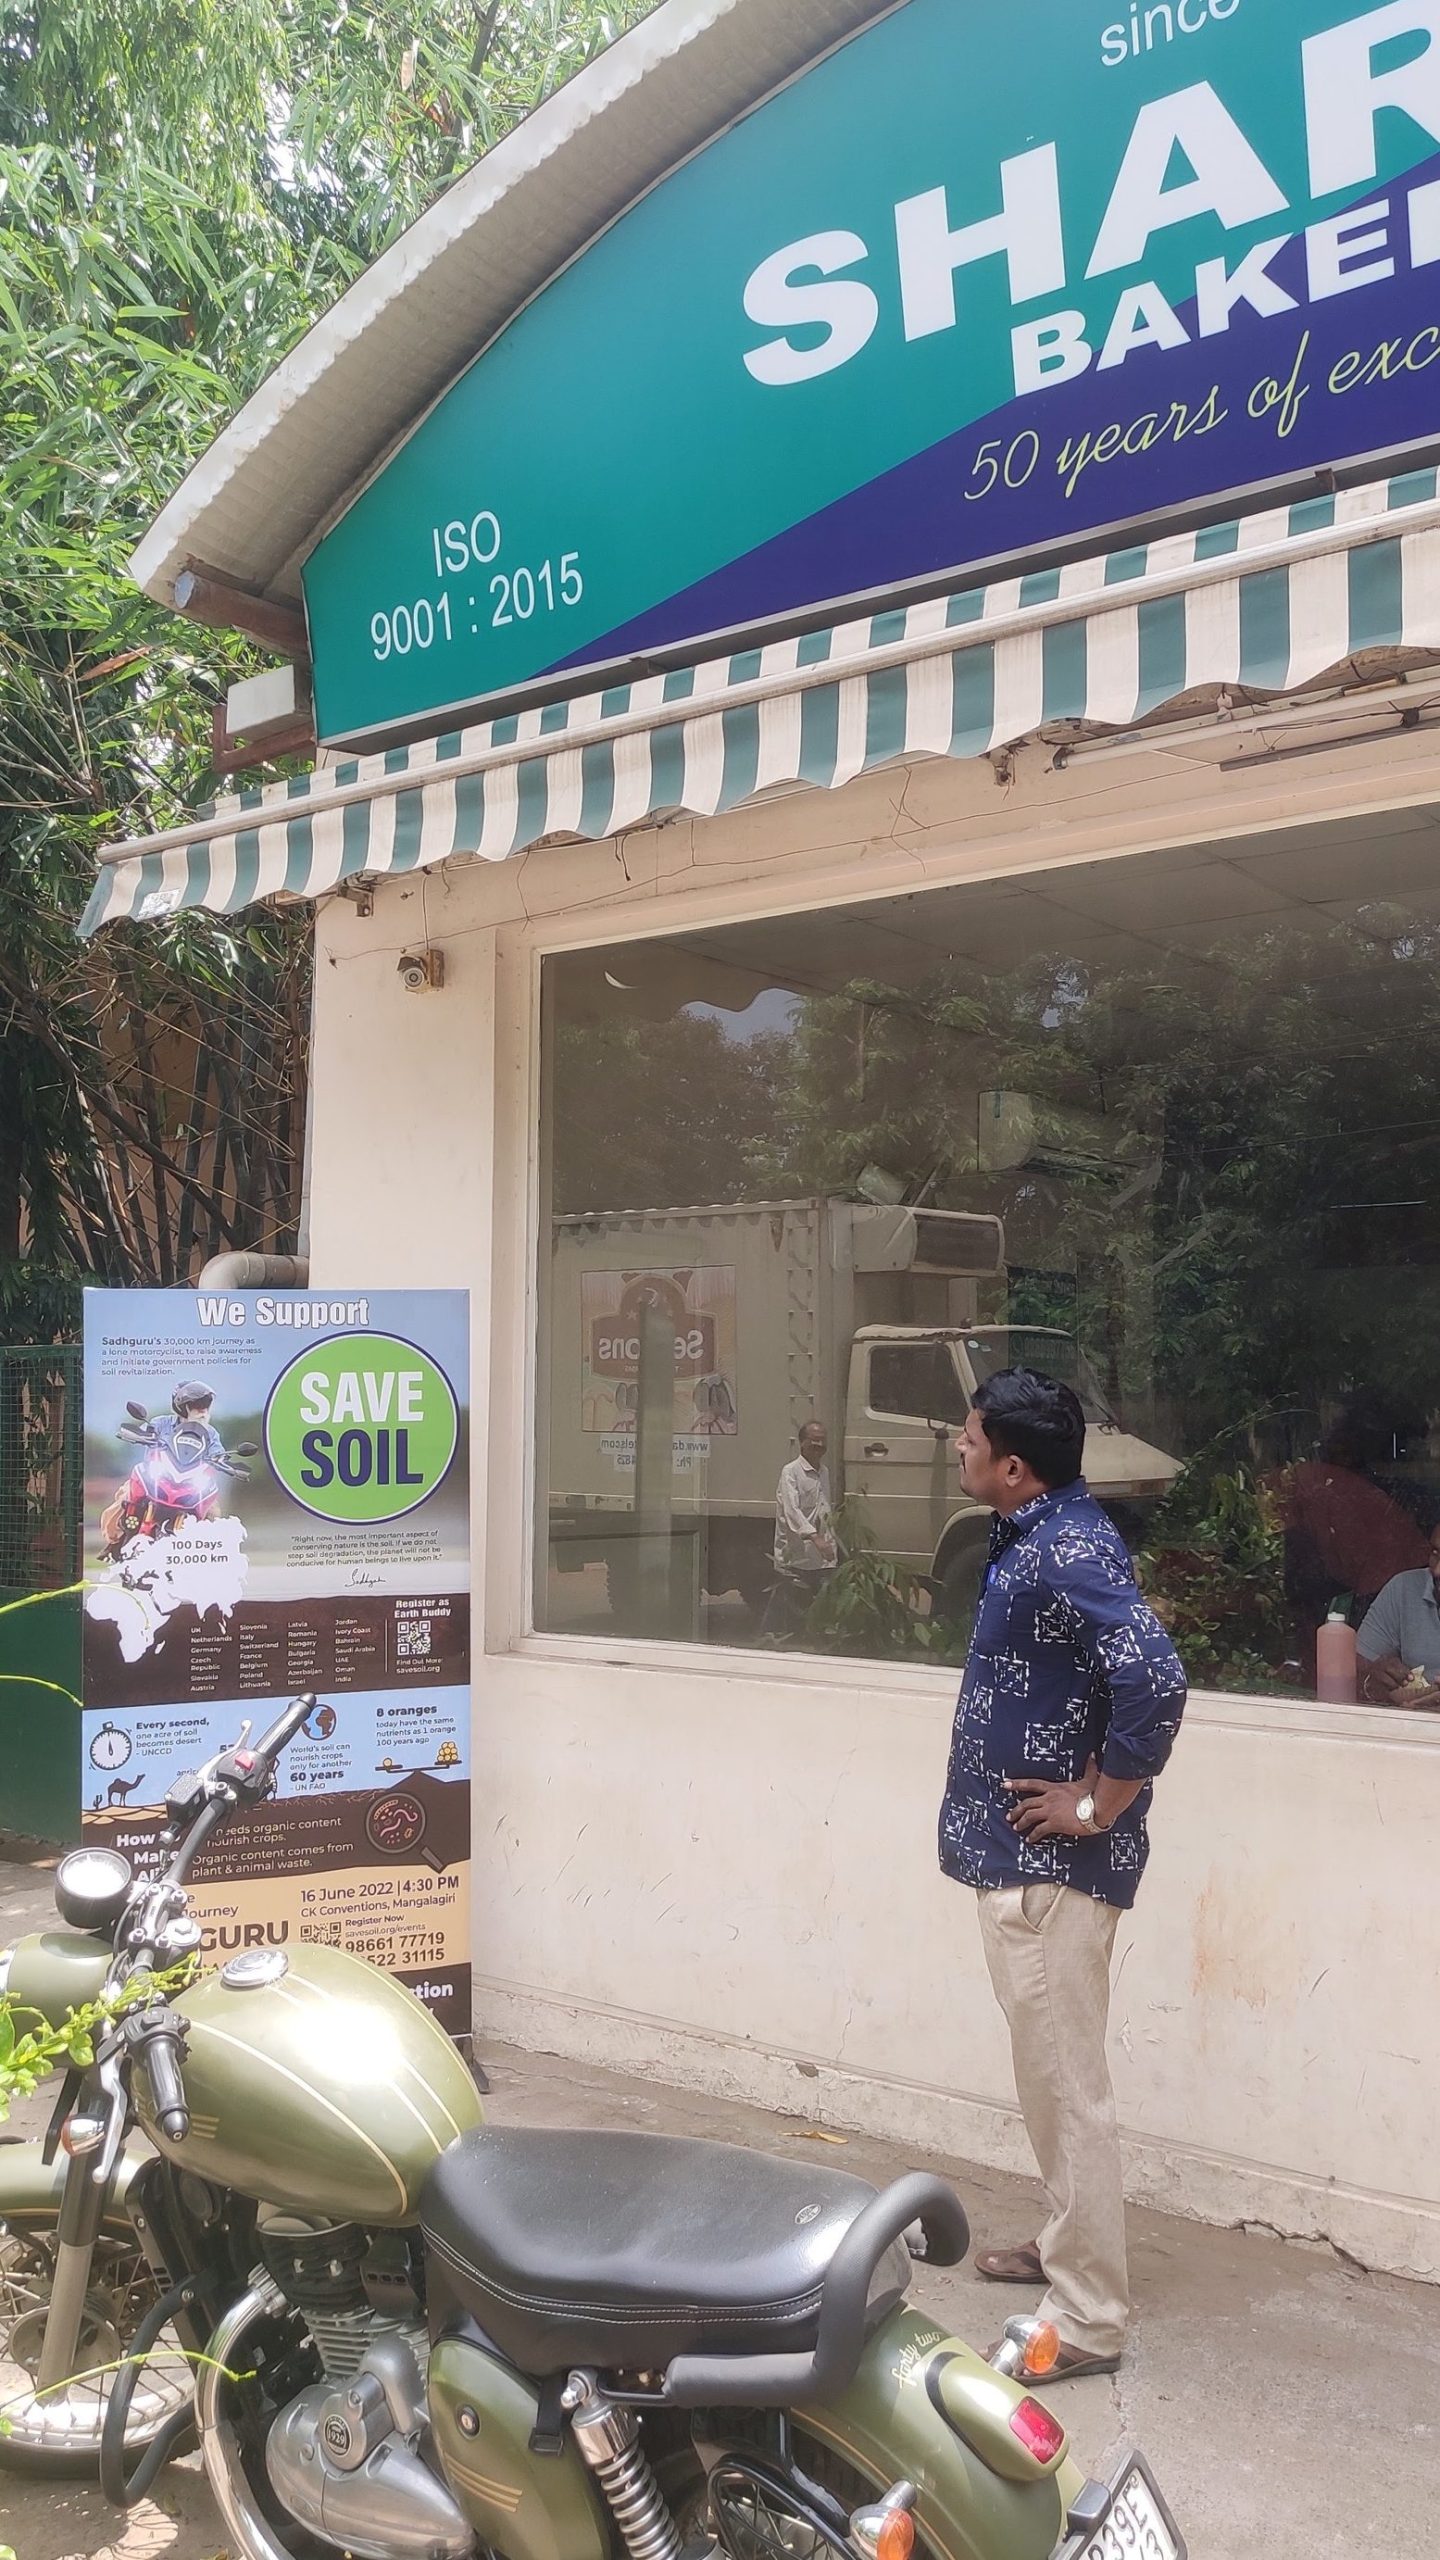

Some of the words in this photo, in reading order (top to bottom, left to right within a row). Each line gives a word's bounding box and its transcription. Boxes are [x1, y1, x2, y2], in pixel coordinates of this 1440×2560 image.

[964, 431, 1039, 501] 50
[1057, 385, 1228, 498] years
[1247, 331, 1310, 437] of
[433, 510, 500, 577] ISO
[371, 591, 451, 661] 9001
[489, 551, 583, 628] 2015
[196, 1297, 246, 1327] We
[256, 1297, 369, 1329] Support
[102, 1337, 162, 1347] Sadhguru's
[164, 1338, 195, 1346] 30,000
[211, 1338, 244, 1346] journey
[197, 1347, 216, 1355] raise
[102, 1358, 118, 1366] and
[120, 1358, 151, 1366] initiate
[152, 1358, 205, 1367] government
[207, 1357, 238, 1366] policies
[301, 1371, 424, 1424] SAVE
[301, 1429, 424, 1488] SOIL
[368, 1533, 404, 1541] important
[172, 1541, 191, 1550] 100
[195, 1541, 222, 1550] Days
[292, 1543, 332, 1551] conserving
[211, 1554, 228, 1562] km
[396, 1599, 436, 1609] Register
[395, 1609, 419, 1618] Earth
[422, 1608, 451, 1618] Buddy
[335, 1618, 358, 1626] Jordan
[335, 1628, 351, 1636] Ivory
[190, 1635, 232, 1643] Netherlands
[190, 1646, 221, 1654] Germany
[288, 1650, 315, 1658] Bulgaria
[190, 1664, 220, 1672] Republic
[240, 1662, 268, 1670] Belgium
[288, 1659, 313, 1667] Georgia
[288, 1668, 322, 1676] Azerbaijan
[396, 1666, 441, 1675] savesoil.org
[376, 1708, 384, 1717] 8
[388, 1705, 437, 1718] oranges
[136, 1721, 166, 1731] Every
[169, 1718, 209, 1728] second,
[376, 1720, 398, 1729] today
[400, 1719, 418, 1727] have
[184, 1728, 198, 1736] soil
[376, 1729, 411, 1737] nutrients
[429, 1726, 456, 1735] orange
[136, 1739, 174, 1748] becomes
[175, 1738, 202, 1746] desert
[393, 1738, 414, 1746] years
[416, 1737, 429, 1745] ago
[142, 1747, 172, 1756] UNCCD
[290, 1745, 319, 1753] World's
[290, 1754, 320, 1762] nourish
[322, 1752, 343, 1760] crops
[290, 1763, 307, 1771] only
[322, 1760, 352, 1768] another
[290, 1772, 306, 1782] 60
[310, 1770, 344, 1782] years
[253, 1821, 295, 1835] organic
[298, 1817, 341, 1829] content
[116, 1834, 156, 1847] How
[253, 1833, 286, 1845] crops.
[192, 1853, 238, 1866] Organic
[240, 1849, 285, 1860] content
[287, 1846, 324, 1857] comes
[327, 1842, 353, 1853] from
[192, 1866, 222, 1879] plant
[225, 1864, 233, 1874] &
[235, 1861, 275, 1873] animal
[277, 1858, 312, 1869] waste.
[301, 1889, 315, 1902] 16
[319, 1887, 355, 1900] June
[359, 1882, 393, 1897] 2022
[403, 1878, 433, 1892] 4:30
[438, 1875, 459, 1889] PM
[301, 1908, 317, 1917] CK
[319, 1901, 390, 1916] Conventions,
[393, 1893, 456, 1908] Mangalagiri
[345, 1916, 382, 1927] Register
[384, 1915, 404, 1923] Now
[345, 1923, 426, 1938] savesoil.org/events
[346, 1937, 393, 1952] 98661
[399, 1932, 445, 1948] 77719
[402, 1948, 445, 1963] 31115
[892, 2342, 923, 2389] forty
[914, 2331, 942, 2350] two
[327, 2429, 345, 2445] 1929
